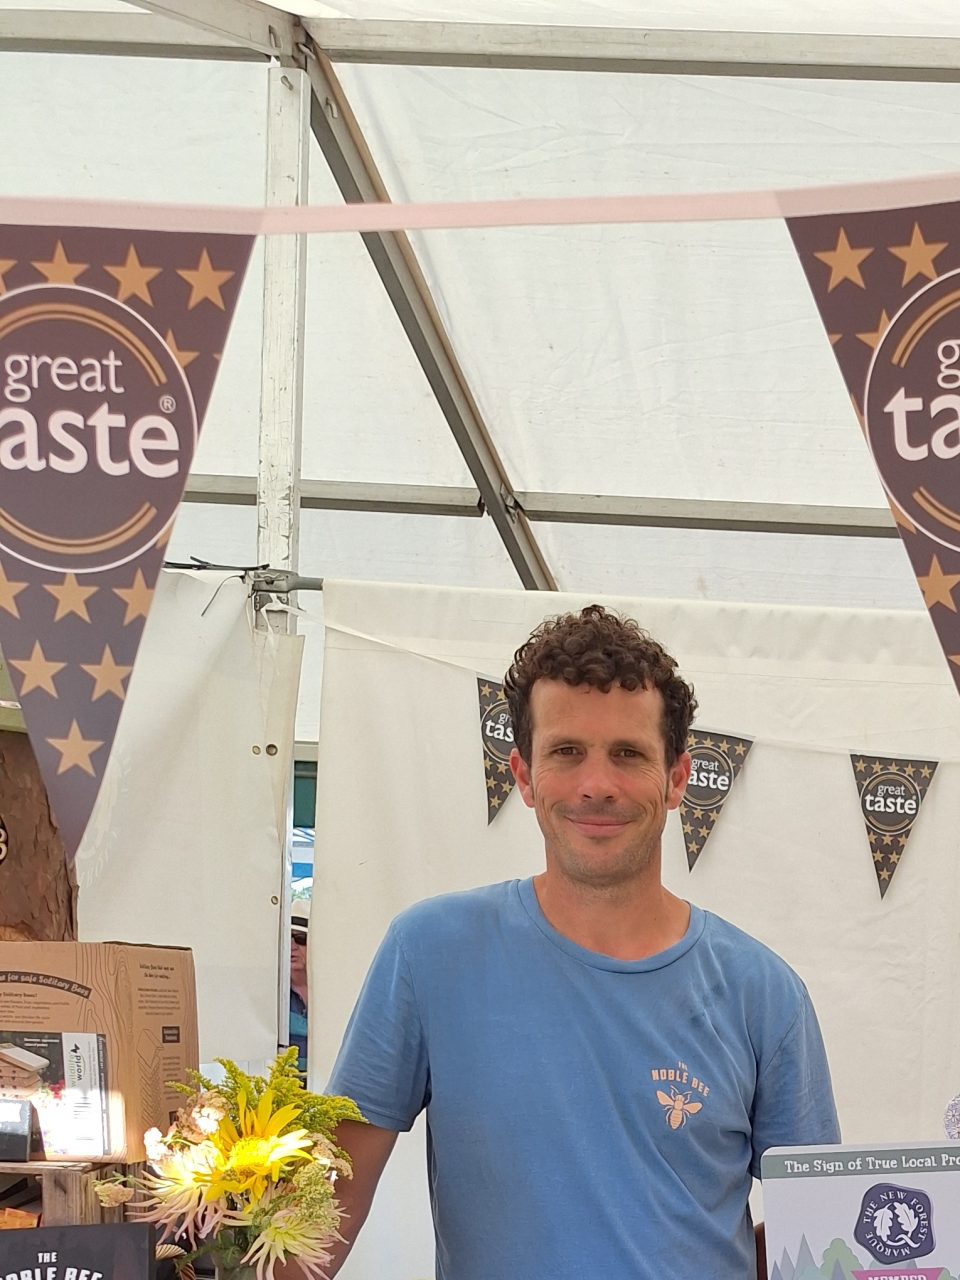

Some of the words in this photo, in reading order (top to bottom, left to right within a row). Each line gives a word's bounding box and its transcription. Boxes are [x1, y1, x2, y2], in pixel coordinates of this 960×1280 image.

[4, 349, 125, 403] great
[0, 402, 180, 478] aste
[485, 720, 514, 742] tas
[691, 758, 719, 772] great
[687, 769, 729, 791] aste
[876, 783, 906, 797] great
[864, 793, 917, 815] taste
[39, 976, 69, 990] Solitary
[71, 983, 89, 996] Bees
[75, 1055, 83, 1081] world
[651, 1069, 689, 1084] NOBLE
[691, 1077, 710, 1097] BEE
[784, 1160, 812, 1174] The
[813, 1160, 844, 1175] Sign
[847, 1157, 863, 1171] of
[866, 1156, 898, 1170] True
[901, 1154, 938, 1168] Local
[880, 1190, 907, 1202] NEW
[863, 1201, 878, 1224] THE
[910, 1198, 929, 1241] FOREST
[865, 1231, 911, 1257] MARQUE
[37, 1252, 58, 1263] THE
